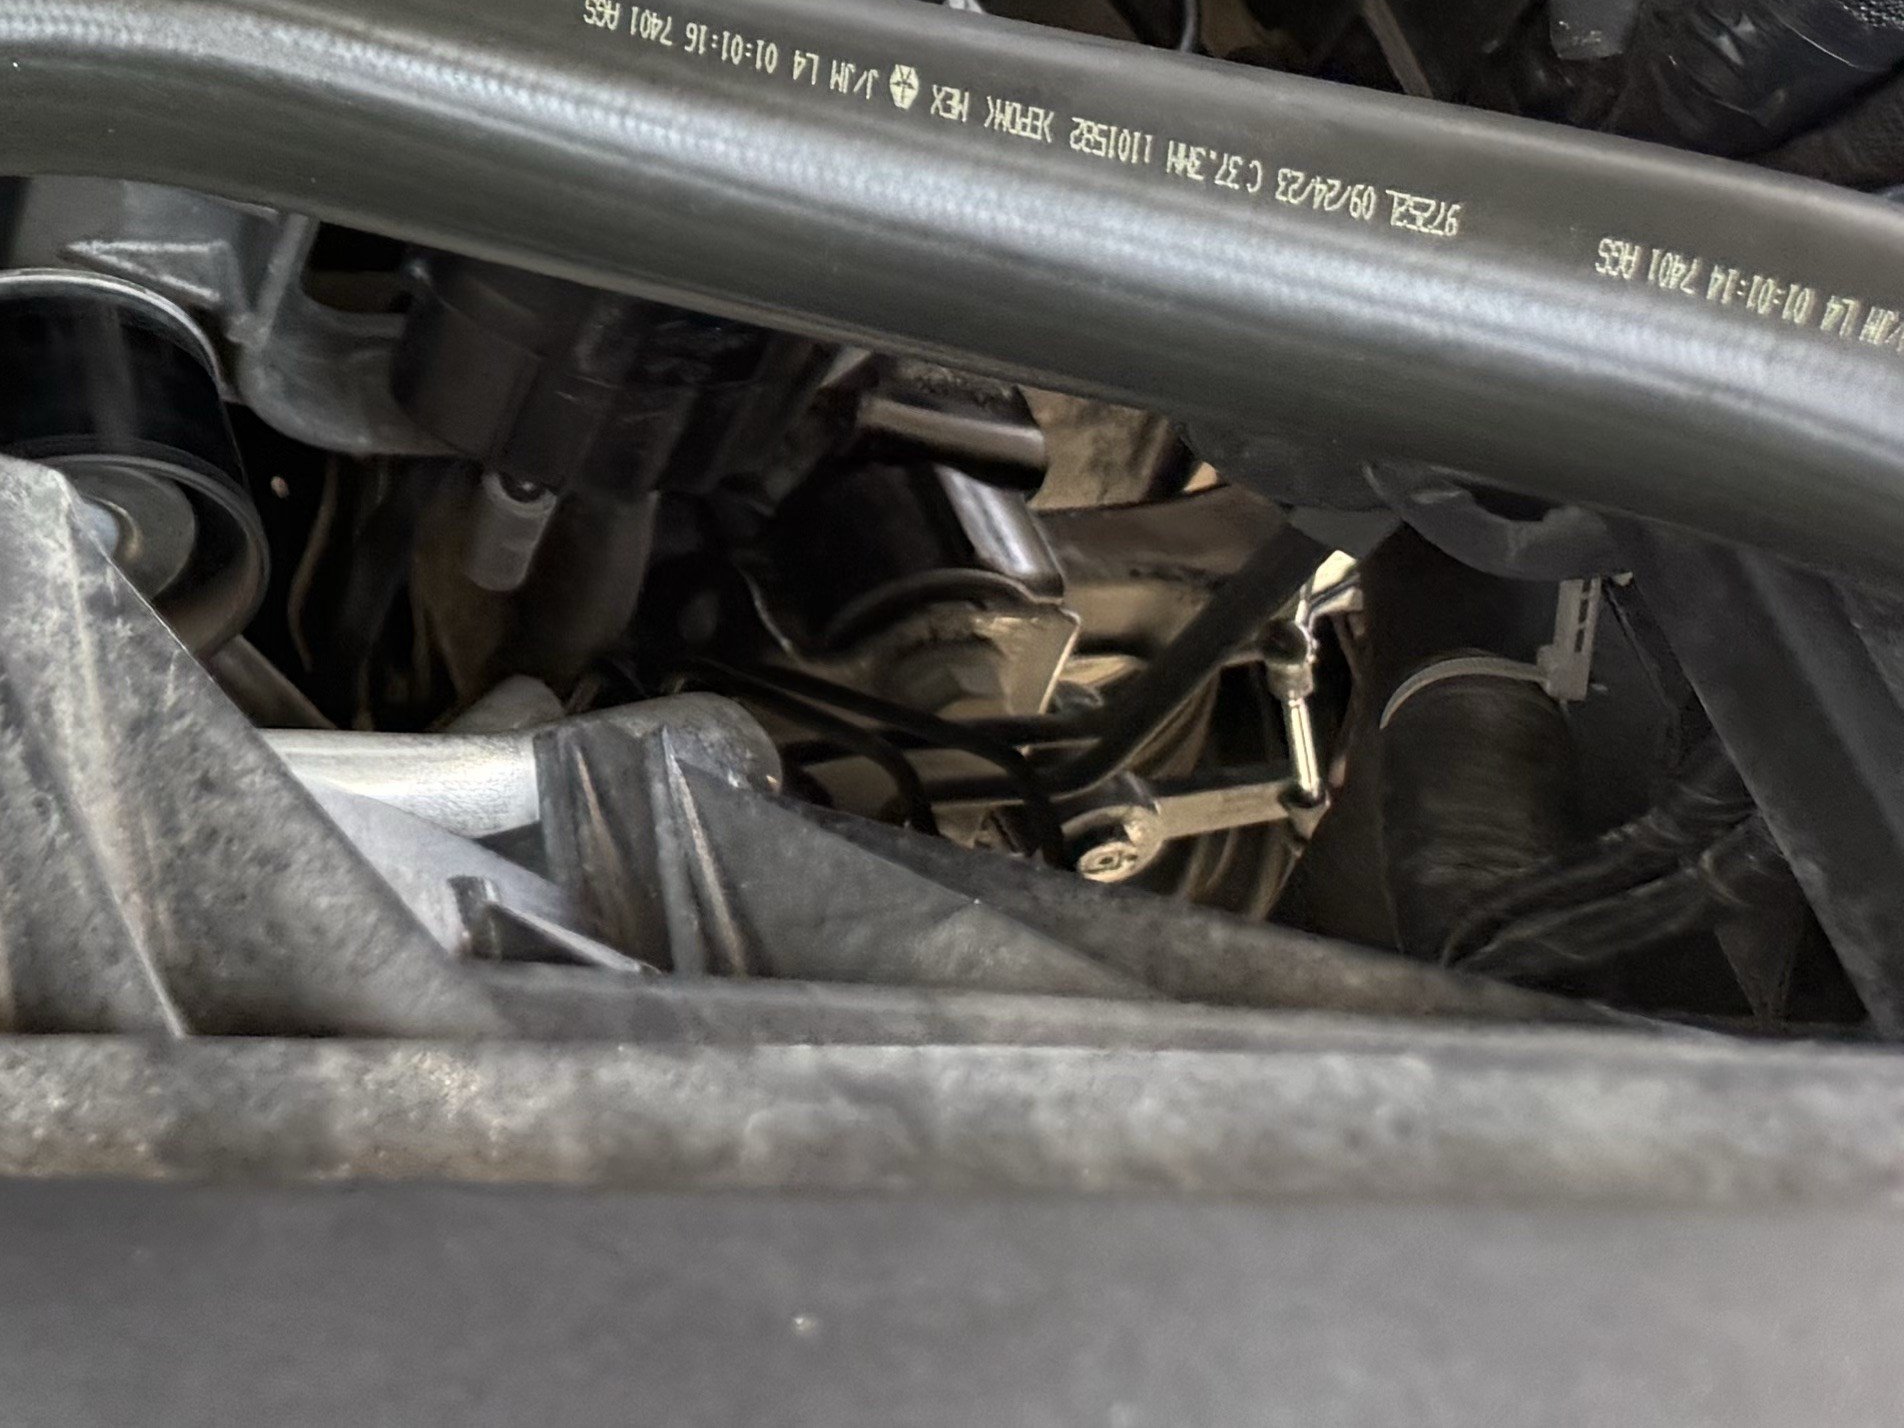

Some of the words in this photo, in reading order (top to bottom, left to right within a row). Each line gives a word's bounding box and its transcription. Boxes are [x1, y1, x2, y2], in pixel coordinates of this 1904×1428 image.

[630, 5, 674, 47] 7401
[685, 20, 778, 71] 01:01:16
[792, 48, 819, 86] L4
[830, 59, 879, 101] J/JM
[930, 83, 970, 123] MEX
[1069, 116, 1154, 165] 1101582
[1275, 167, 1376, 221] 09/24/23
[1593, 237, 1643, 280] AGS
[1646, 247, 1703, 296] 7401
[1706, 263, 1815, 326] 01:01:14
[1819, 294, 1860, 339] L4
